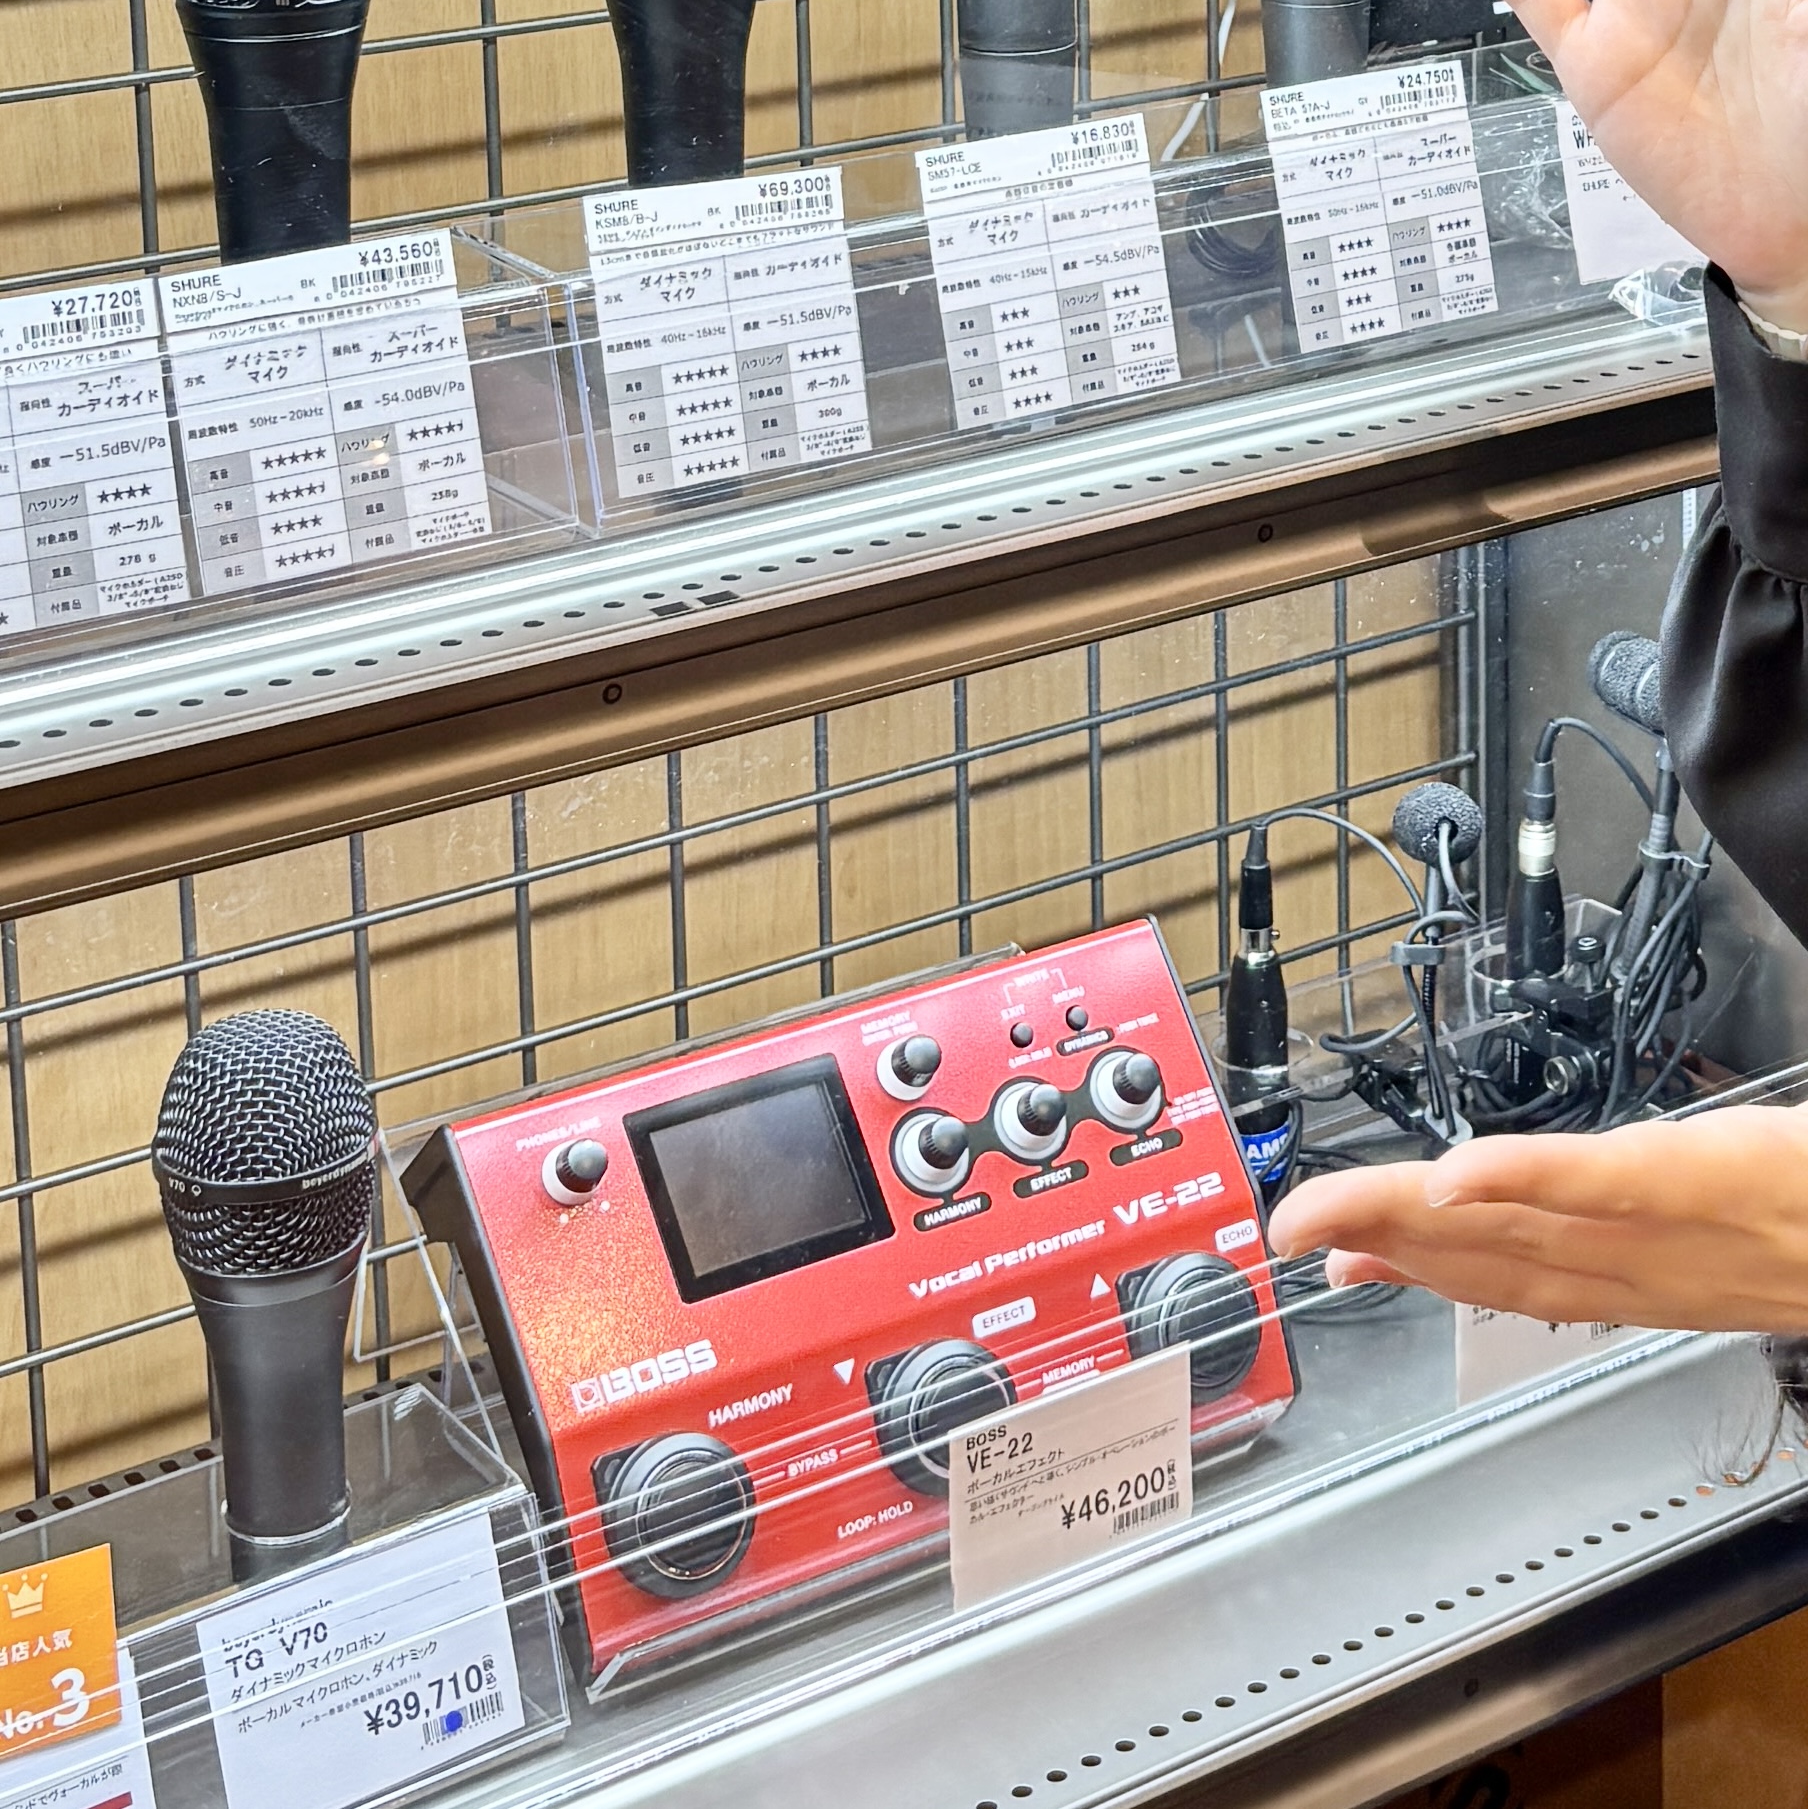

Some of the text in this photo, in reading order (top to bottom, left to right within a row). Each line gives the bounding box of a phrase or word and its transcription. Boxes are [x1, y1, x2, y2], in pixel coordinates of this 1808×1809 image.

[1270, 92, 1304, 106] SHURE
[1271, 106, 1296, 119] BETA
[925, 152, 964, 168] SHURE
[1408, 145, 1471, 166] カーディオイド
[1326, 167, 1353, 181] マイク
[594, 200, 639, 215] SHURE
[987, 230, 1019, 245] マイク
[765, 254, 842, 276] カーディオイド
[171, 274, 222, 293] SHURE
[301, 278, 316, 289] BK
[640, 267, 712, 291] ダイナミック
[661, 287, 696, 303] マイク
[1062, 291, 1099, 307] ハウリング
[388, 325, 439, 342] スーパー
[370, 336, 459, 363] カーディオイド
[741, 353, 783, 372] ハウリング
[184, 374, 205, 388] 方式
[248, 364, 289, 383] マイク
[807, 375, 851, 392] ボーカル
[57, 389, 160, 418] カーディオイド
[374, 380, 466, 408] -54.0dBV/Pa
[417, 452, 466, 472] ボーカル
[209, 468, 229, 481] 高音
[27, 493, 79, 514] ハウリング
[214, 500, 233, 512] 中音
[107, 516, 164, 536] ボーカル
[219, 533, 239, 546] 低音
[224, 565, 244, 578] 音圧
[50, 599, 82, 613] 付属品
[1131, 1137, 1163, 1158] ECHO
[1030, 1167, 1073, 1191] EFFECT
[924, 1197, 983, 1227] HARMONY
[908, 1171, 1225, 1300] Vocal Performer VE-22
[1221, 1225, 1253, 1246] ECHO
[982, 1304, 1026, 1329] EFFECT
[601, 1339, 718, 1404] BOSS
[1042, 1355, 1095, 1384] MEMORY
[708, 1383, 793, 1429] HARMONY
[967, 1425, 1007, 1451] BOSS
[787, 1449, 838, 1478] BYPASS
[967, 1433, 1033, 1474] VE-22
[967, 1448, 1064, 1494] ボーカルエフェクト
[1062, 1467, 1165, 1529] ¥46,200
[838, 1501, 914, 1539] LOOP: HOLD
[225, 1621, 329, 1679] TG V70
[231, 1630, 386, 1704] ダイナミックマイクロホン
[238, 1640, 437, 1734] ボーカルマイクロホン、ダイナミック
[363, 1663, 484, 1735] ¥39,710
